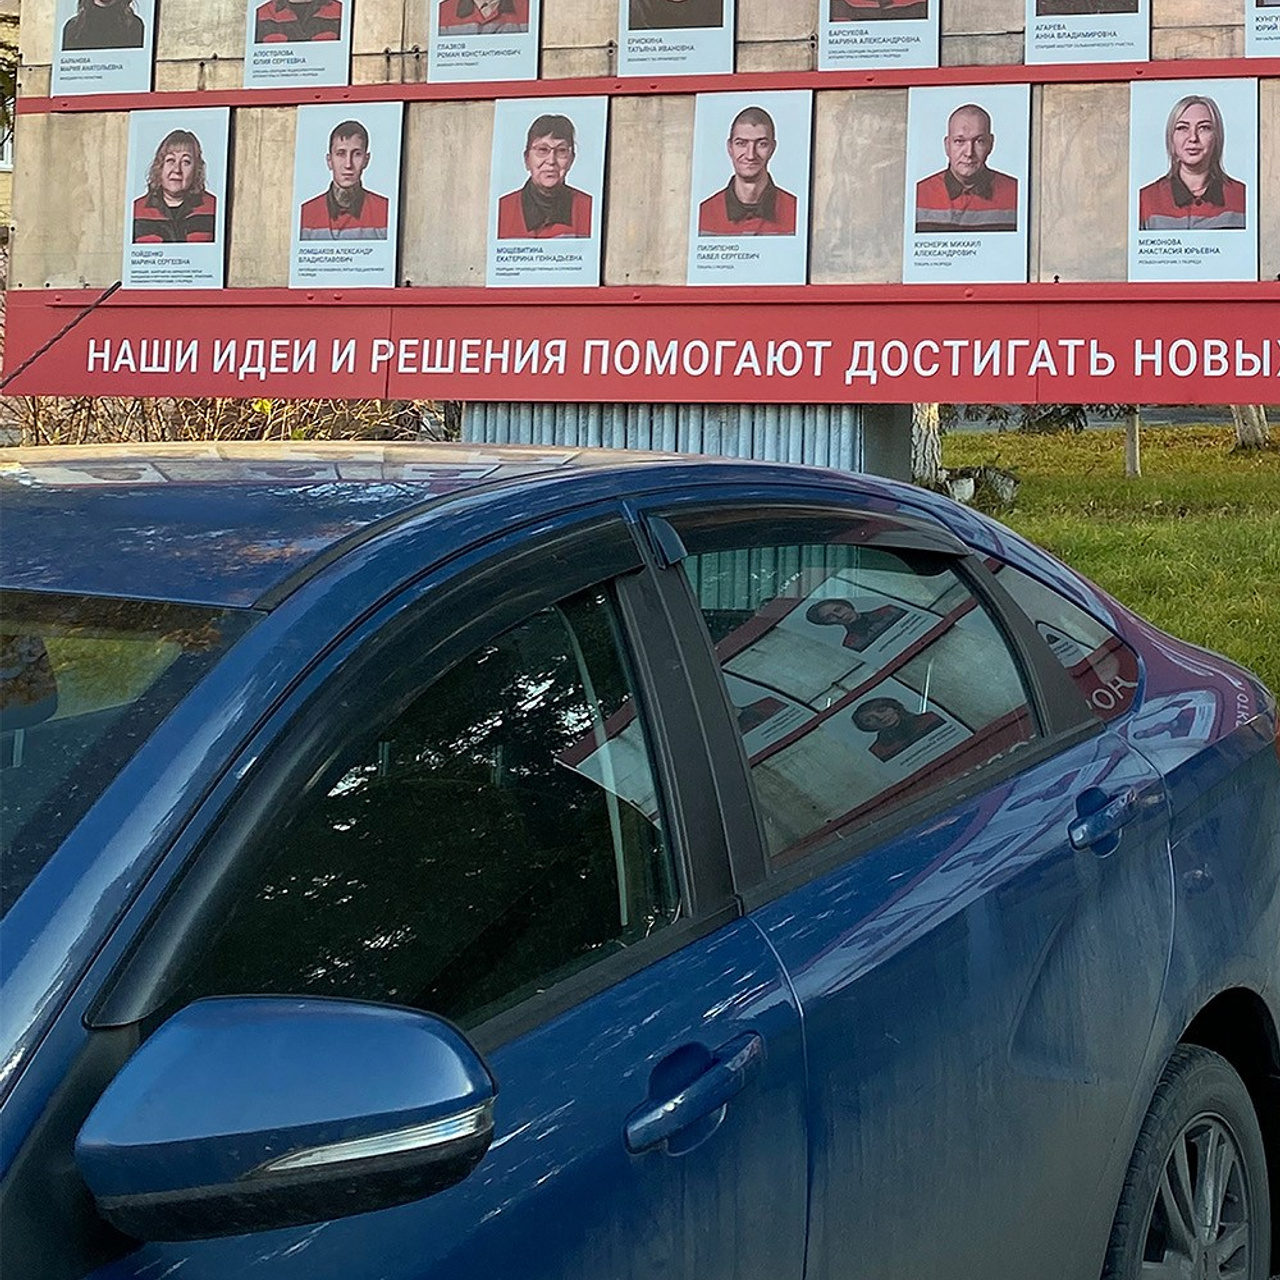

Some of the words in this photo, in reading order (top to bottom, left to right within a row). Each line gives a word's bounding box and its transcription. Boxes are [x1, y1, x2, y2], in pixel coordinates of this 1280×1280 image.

[1035, 23, 1067, 31] АГАРЕВА
[1255, 23, 1278, 31] ЮРИЙ
[828, 29, 869, 37] БАРСУКОВА
[1057, 31, 1117, 39] ВЛАДИМИРОВНА
[859, 36, 921, 45] АЛЕКСАНДРОВНА
[461, 49, 521, 57] КОНСТАНТИНОВИЧ
[950, 240, 981, 248] МИХАИЛ
[914, 249, 977, 257] АЛЕКСАНДРОВИЧ
[1138, 247, 1182, 255] АНАСТАСИЯ
[87, 338, 198, 373] НАШИ
[213, 338, 316, 382] ИДЕИ
[331, 338, 357, 374] И
[371, 338, 566, 375] РЕШЕНИЯ
[582, 338, 832, 378] ПОМОГАЮТ
[845, 338, 1116, 385] ДОСТИГАТЬ
